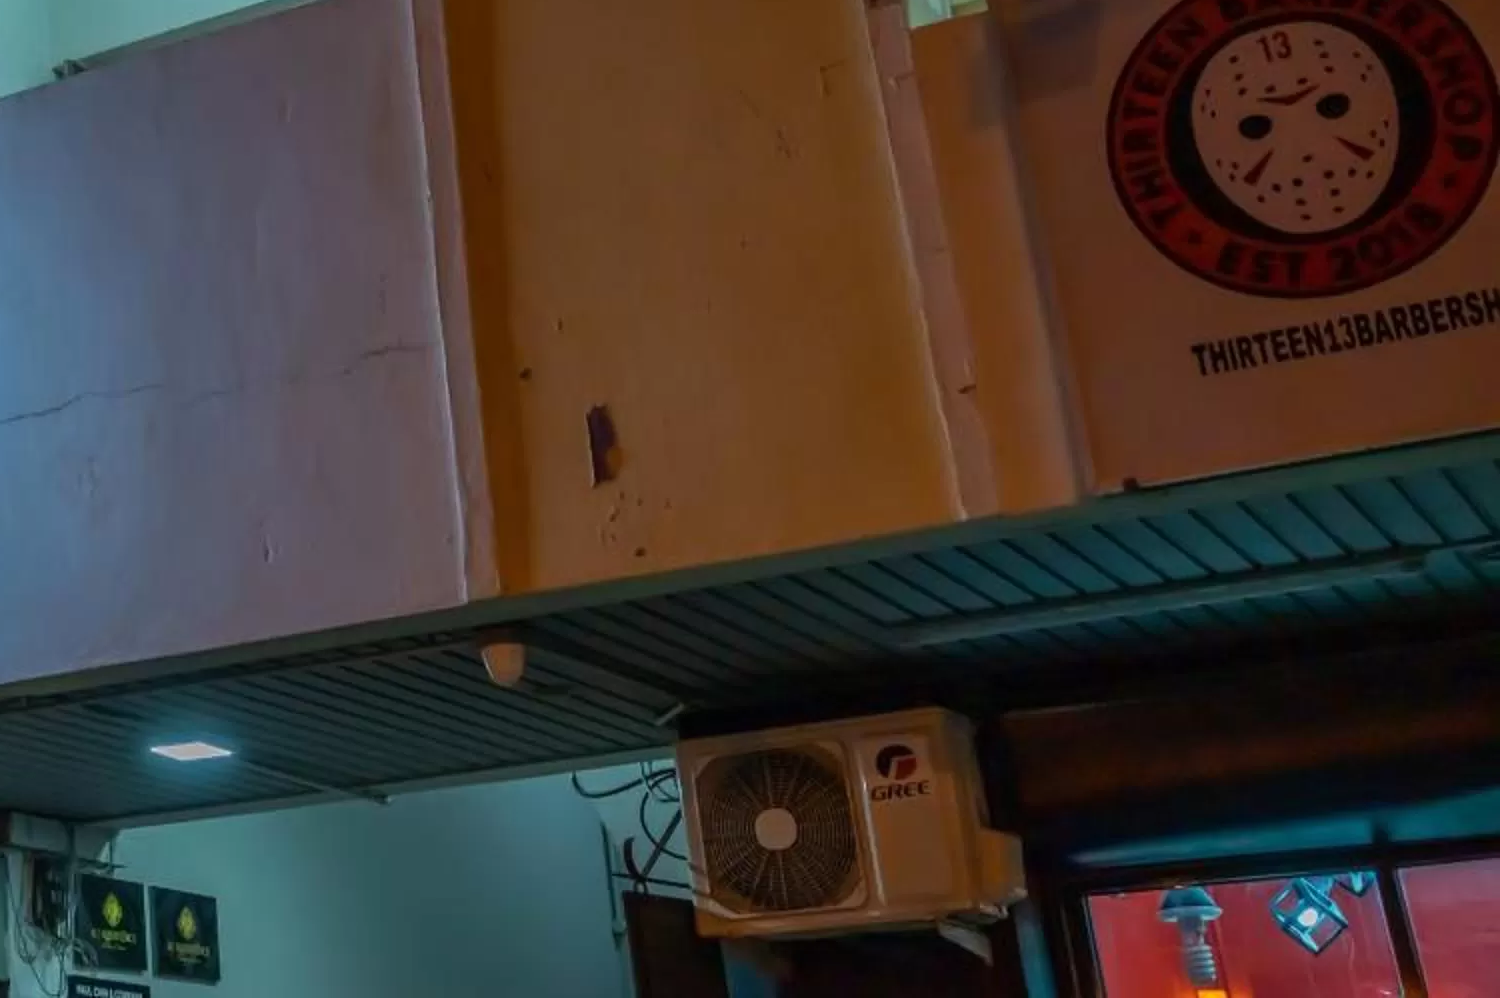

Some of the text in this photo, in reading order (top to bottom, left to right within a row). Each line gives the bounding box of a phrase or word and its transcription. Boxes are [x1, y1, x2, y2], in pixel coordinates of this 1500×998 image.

[1258, 31, 1291, 62] 13
[1122, 17, 1206, 230] THIRTEEN
[1216, 241, 1308, 285] EST
[871, 780, 931, 801] GREE
